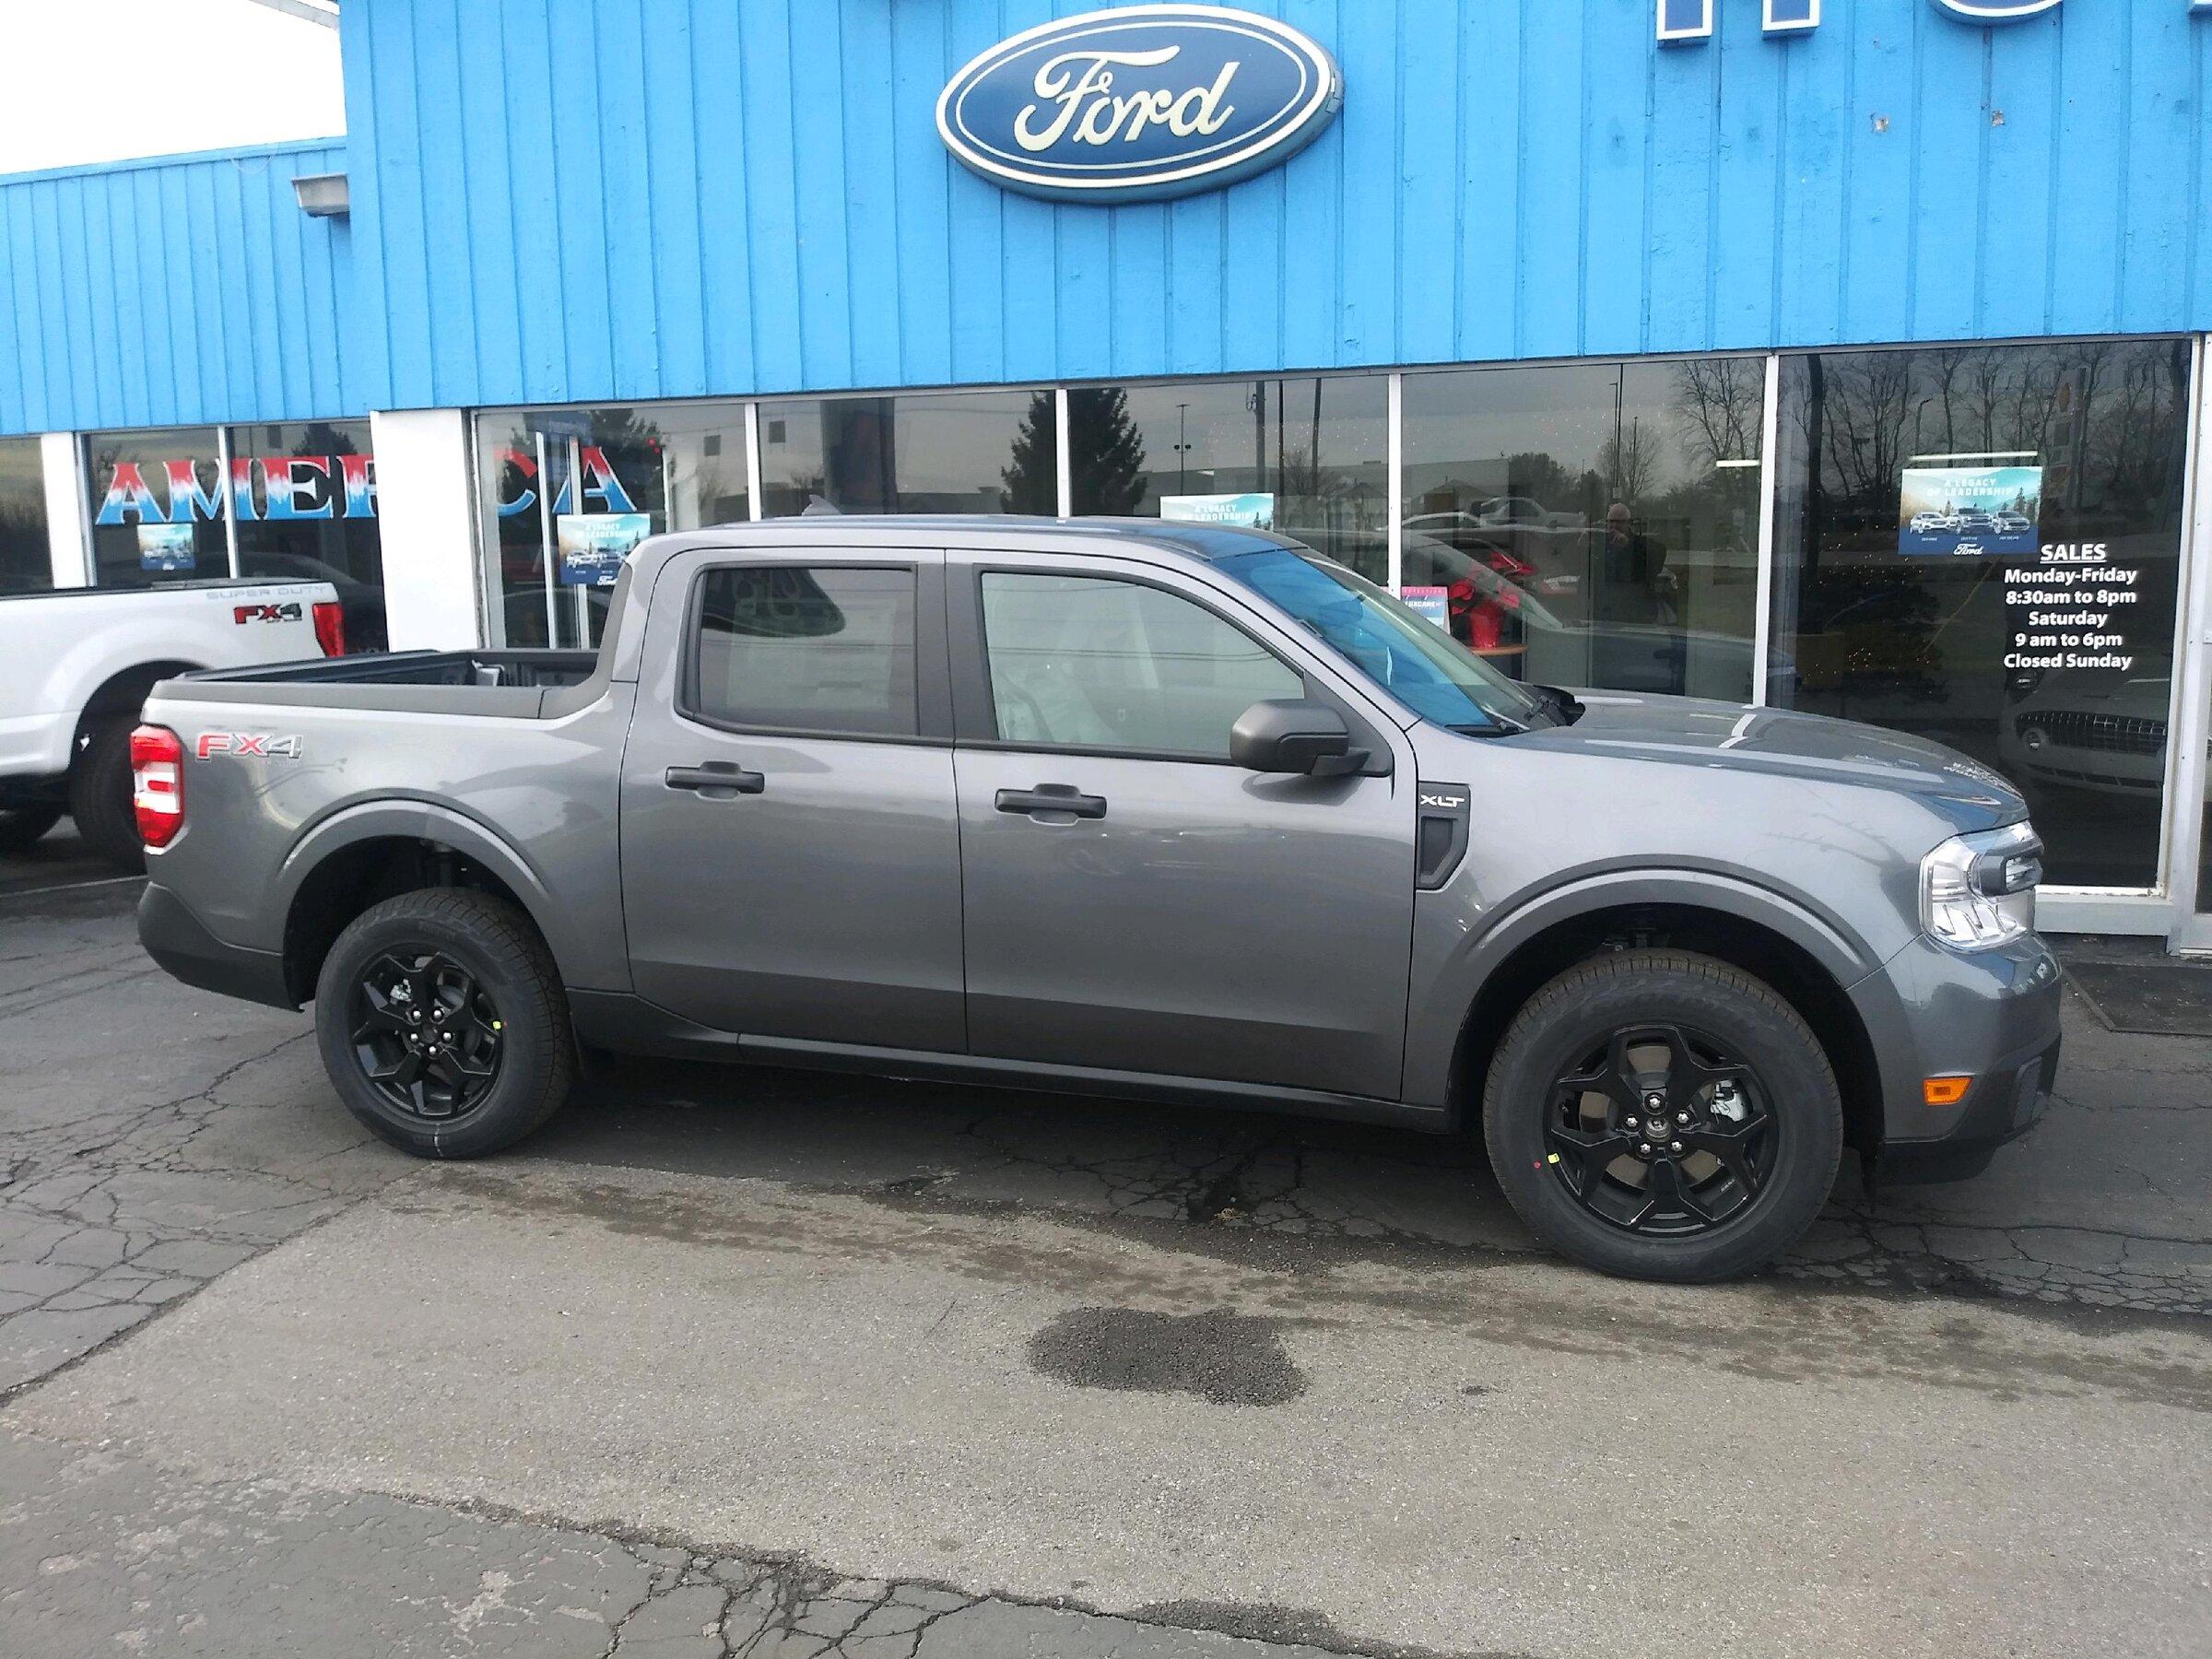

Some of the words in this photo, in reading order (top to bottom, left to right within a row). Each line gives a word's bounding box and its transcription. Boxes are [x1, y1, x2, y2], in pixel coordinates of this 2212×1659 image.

[1014, 45, 1241, 152] Ford
[1955, 477, 1997, 488] LEGACY
[1953, 543, 1983, 556] Ford
[2040, 543, 2107, 561] SALES
[2004, 568, 2137, 586] Monday-Friday
[2006, 590, 2071, 605] 8:30am
[2074, 591, 2093, 604] to
[2097, 589, 2136, 607] 8pm
[233, 602, 302, 624] FX4
[2029, 610, 2108, 629] Saturday
[2015, 633, 2027, 647] 9
[2030, 634, 2057, 646] am
[2060, 633, 2079, 646] to
[2083, 632, 2124, 650] 6pm
[2004, 653, 2063, 668] Closed
[2066, 653, 2134, 671] Sunday
[196, 733, 303, 760] FX4
[1420, 794, 1465, 807] XLT
